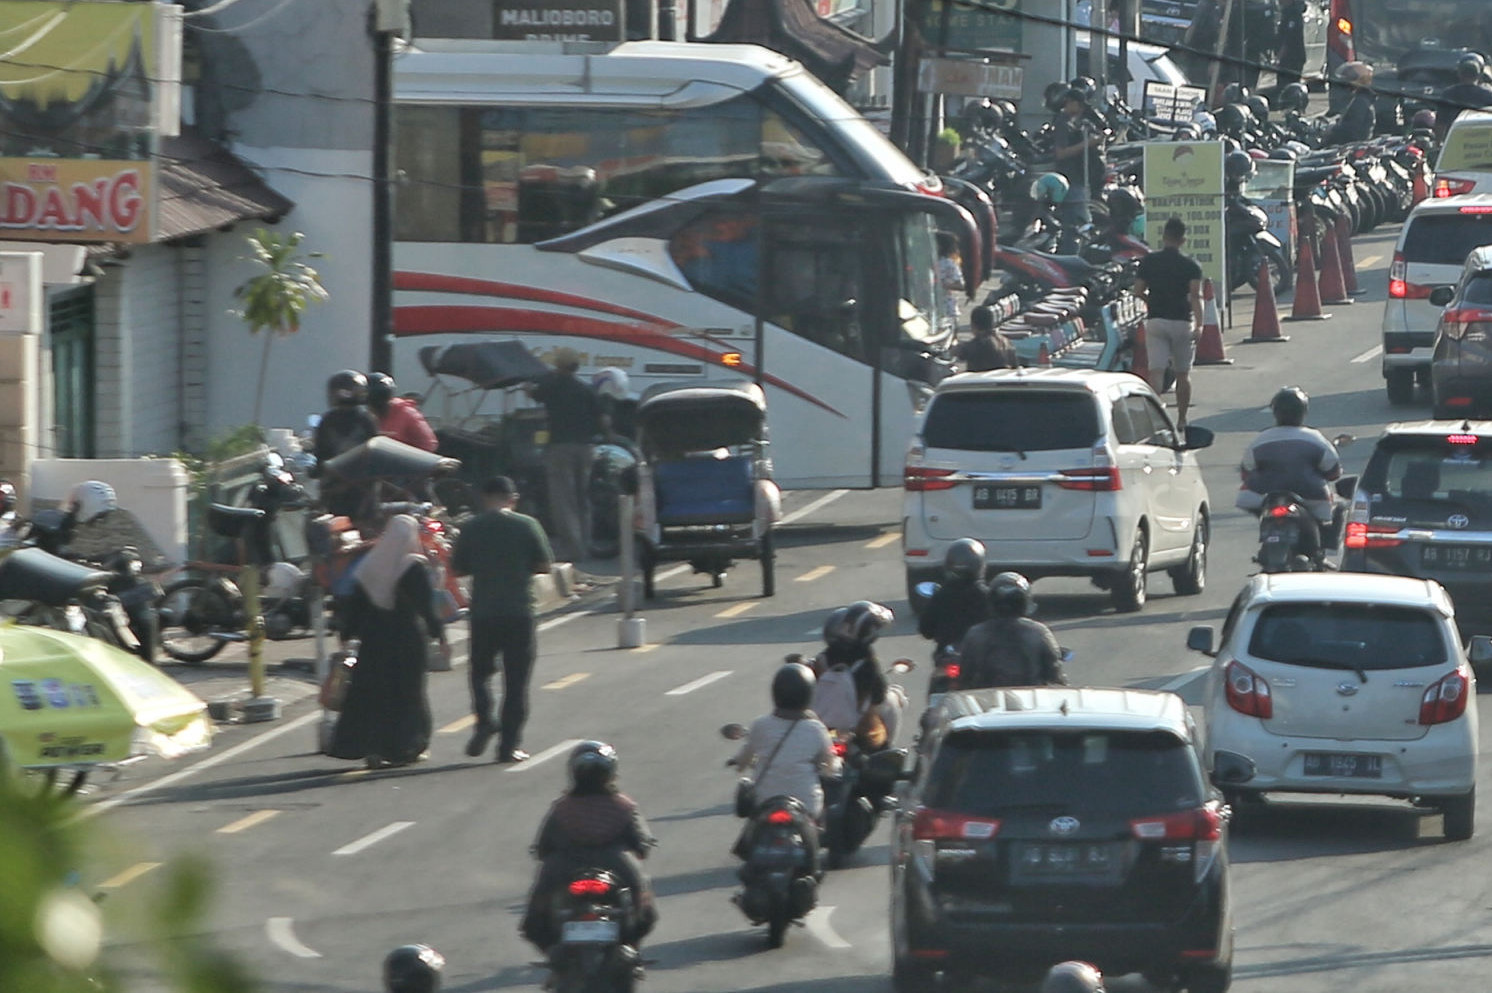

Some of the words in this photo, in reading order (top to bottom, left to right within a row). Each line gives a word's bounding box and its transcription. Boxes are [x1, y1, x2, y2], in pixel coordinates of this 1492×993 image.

[501, 9, 615, 25] MALIOBORO
[975, 487, 989, 501] AB
[1423, 547, 1437, 560] AB
[1446, 548, 1469, 560] 1157
